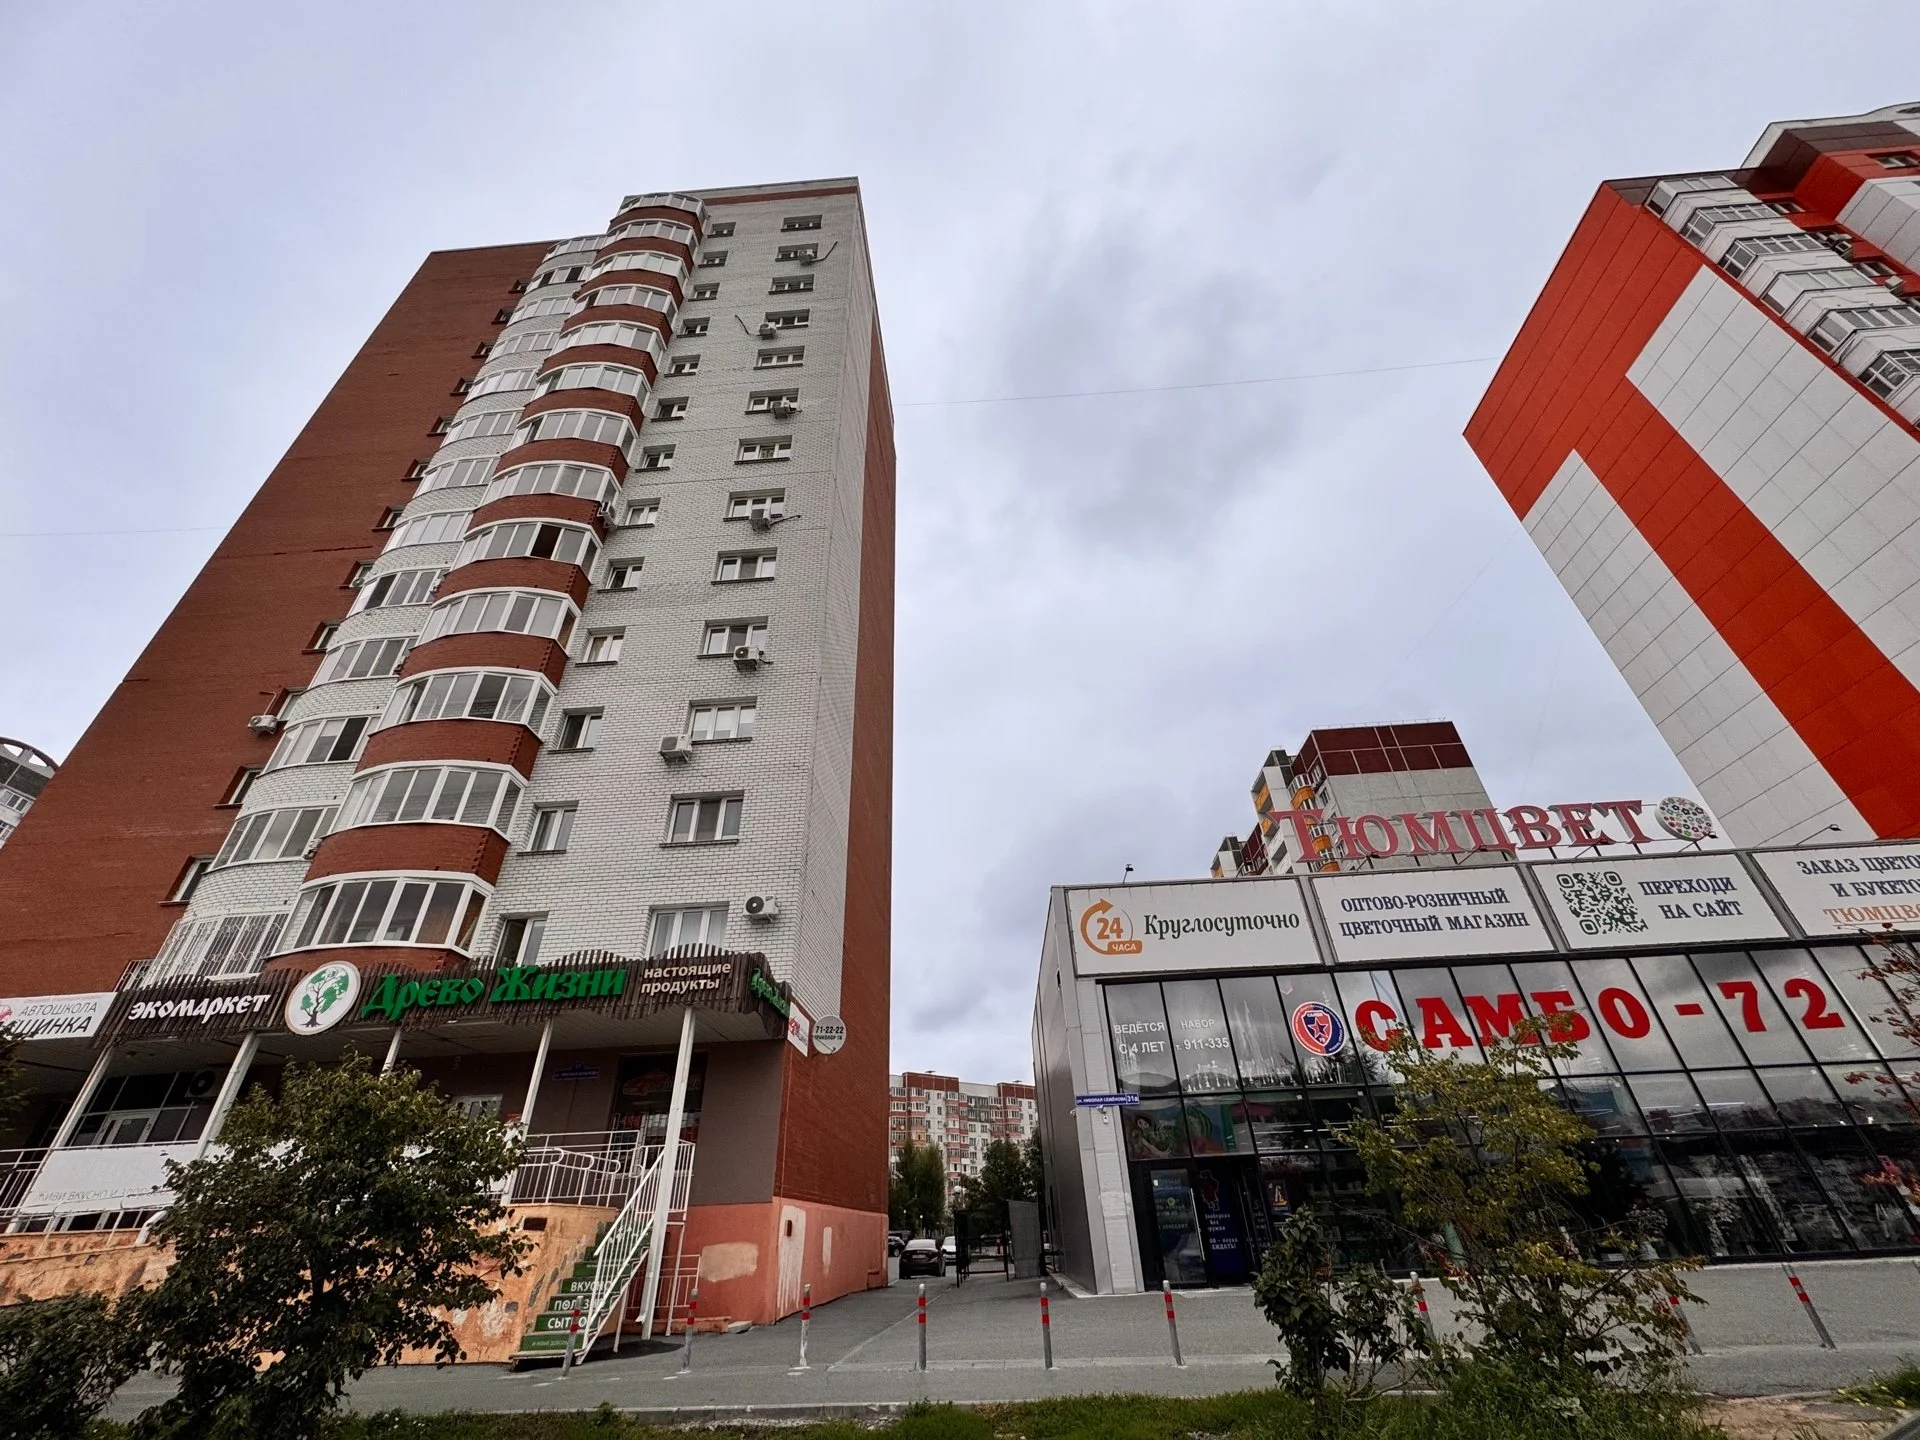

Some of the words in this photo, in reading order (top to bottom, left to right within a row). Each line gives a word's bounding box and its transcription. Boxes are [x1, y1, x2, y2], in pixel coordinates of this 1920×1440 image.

[1269, 799, 1653, 864] ТЮМЦВЕТ
[1796, 858, 1860, 875] ЗАКАЗ
[1860, 854, 1920, 874] ЦВЕТО
[1638, 876, 1738, 896] ПЕРЕХОДИ
[1829, 882, 1850, 897] И
[1849, 878, 1920, 896] БУКЕТО
[1340, 887, 1510, 913] ОПТОВО-РОЗНИЧНЫЙ
[1658, 903, 1691, 920] НА
[1695, 898, 1744, 918] САЙТ
[1096, 917, 1124, 940] 24
[1143, 912, 1300, 941] Круглосуточно
[1339, 914, 1443, 939] ЦВЕТОЧНЫЙ
[1445, 912, 1530, 932] МАГАЗИН
[1112, 943, 1137, 952] ЧАСА
[643, 963, 731, 979] настоящие
[359, 972, 485, 1022] Древо
[488, 964, 627, 1003] Жизни
[640, 978, 720, 996] продукты
[18, 1002, 97, 1017] АВТОШКОЛА
[815, 1025, 844, 1034] 71-22-22
[1114, 1021, 1165, 1035] ВЕДЁТСЯ
[1180, 1019, 1215, 1029] НАБОР
[1118, 1043, 1127, 1054] С
[1129, 1042, 1139, 1054] 4
[1141, 1041, 1165, 1053] ЛЕТ
[1183, 1037, 1230, 1050] 911-335
